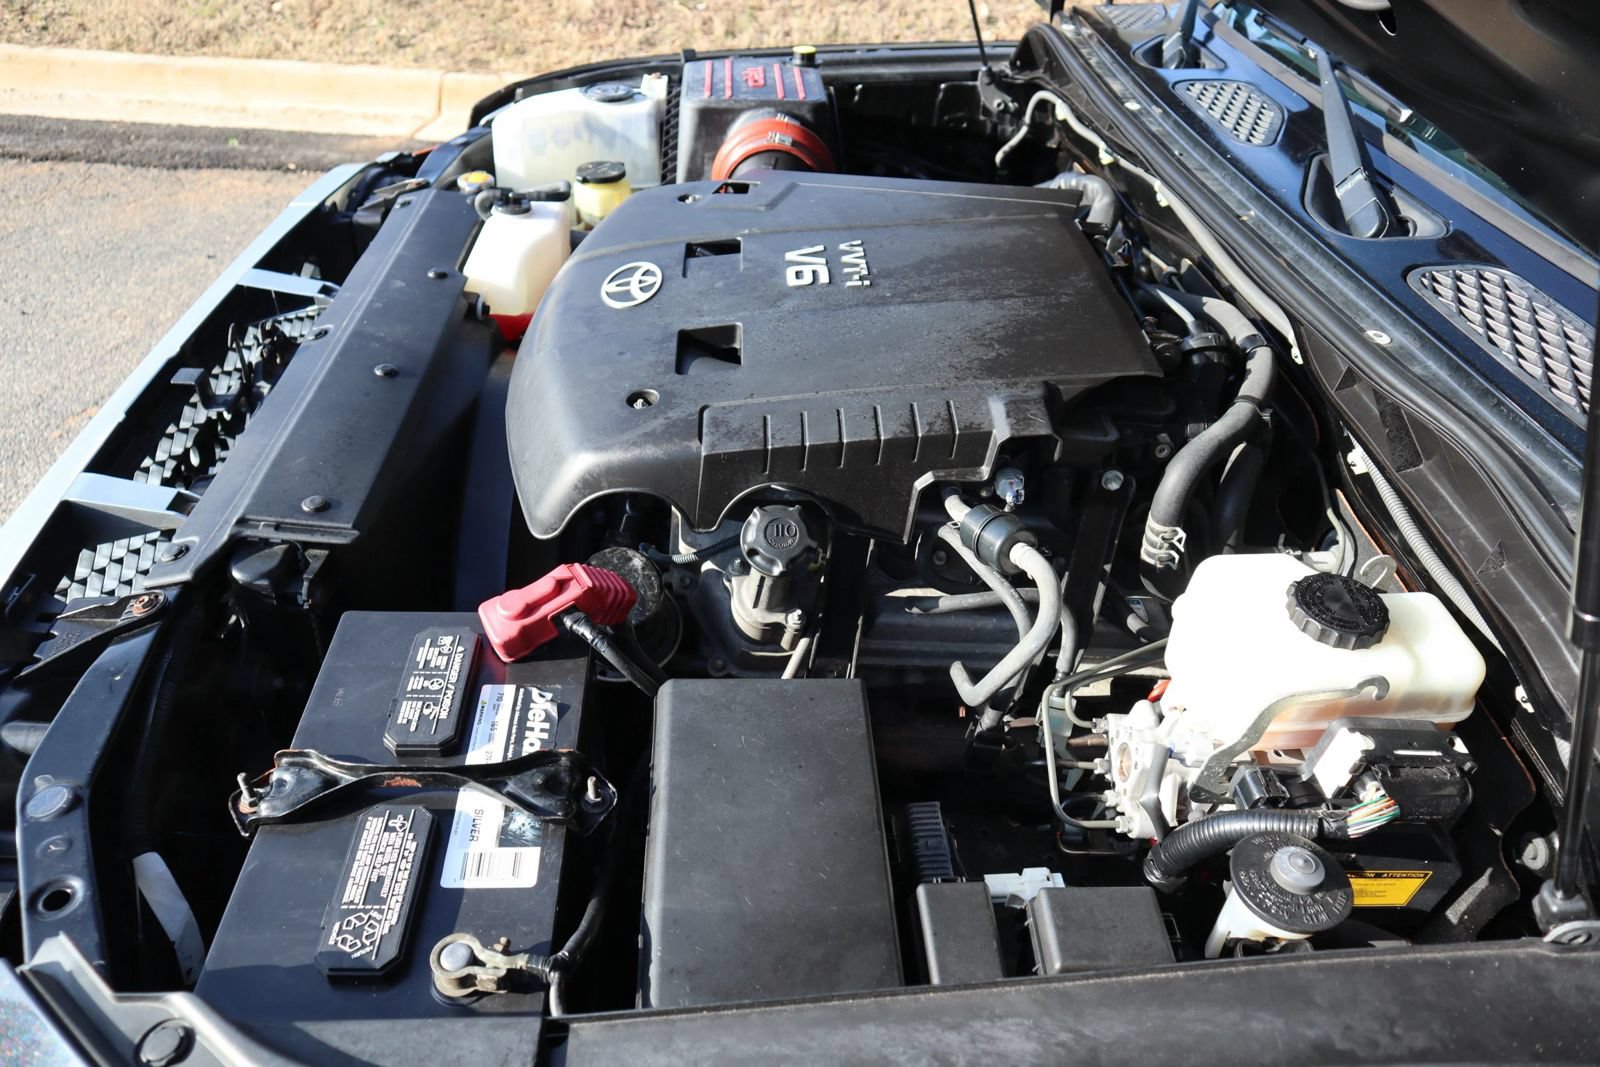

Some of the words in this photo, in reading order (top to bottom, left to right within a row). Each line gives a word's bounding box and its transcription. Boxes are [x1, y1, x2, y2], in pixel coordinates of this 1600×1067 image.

[785, 245, 829, 286] V6
[839, 240, 871, 287] VVT-i
[448, 653, 463, 682] DANGER
[438, 689, 453, 719] POISON
[522, 687, 553, 757] DieHa
[469, 809, 484, 842] SILVER
